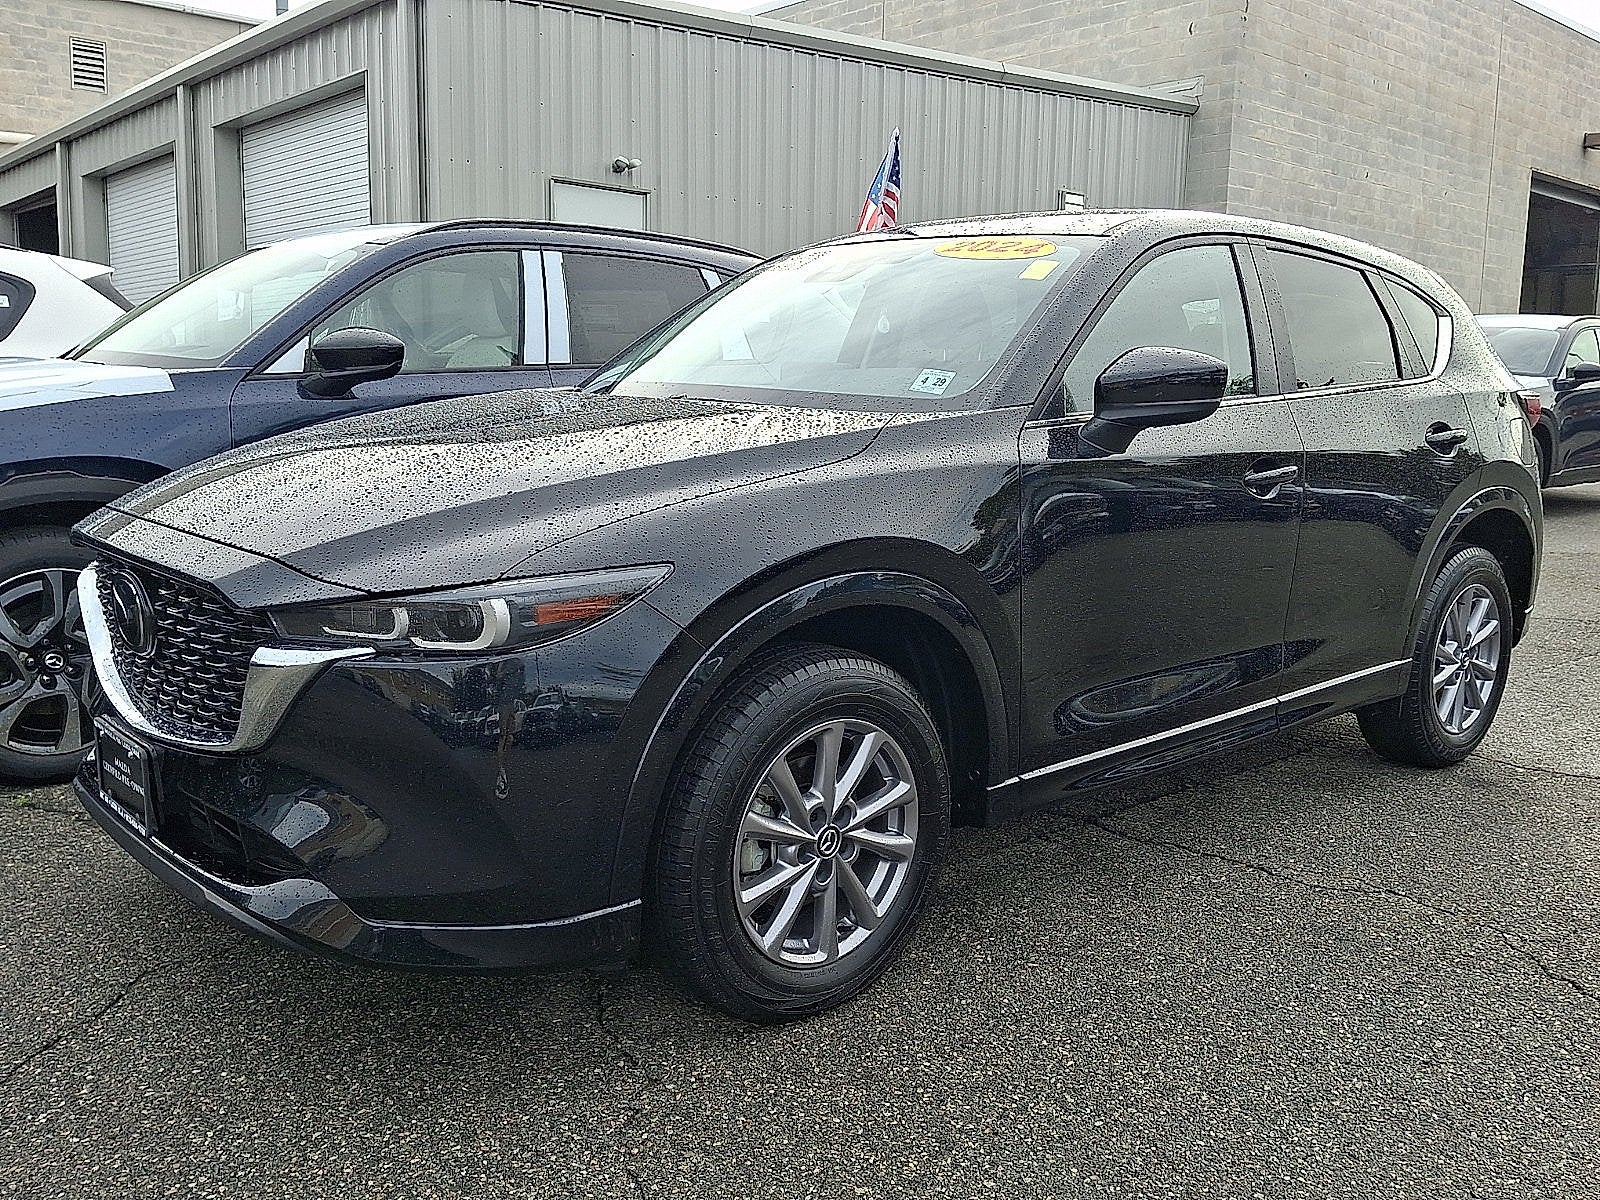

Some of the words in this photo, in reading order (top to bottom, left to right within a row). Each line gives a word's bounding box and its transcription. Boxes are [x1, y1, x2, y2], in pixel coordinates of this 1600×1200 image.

[941, 240, 1049, 255] 2024
[920, 376, 930, 385] 4
[931, 377, 947, 387] 29
[114, 756, 132, 776] MAZDA
